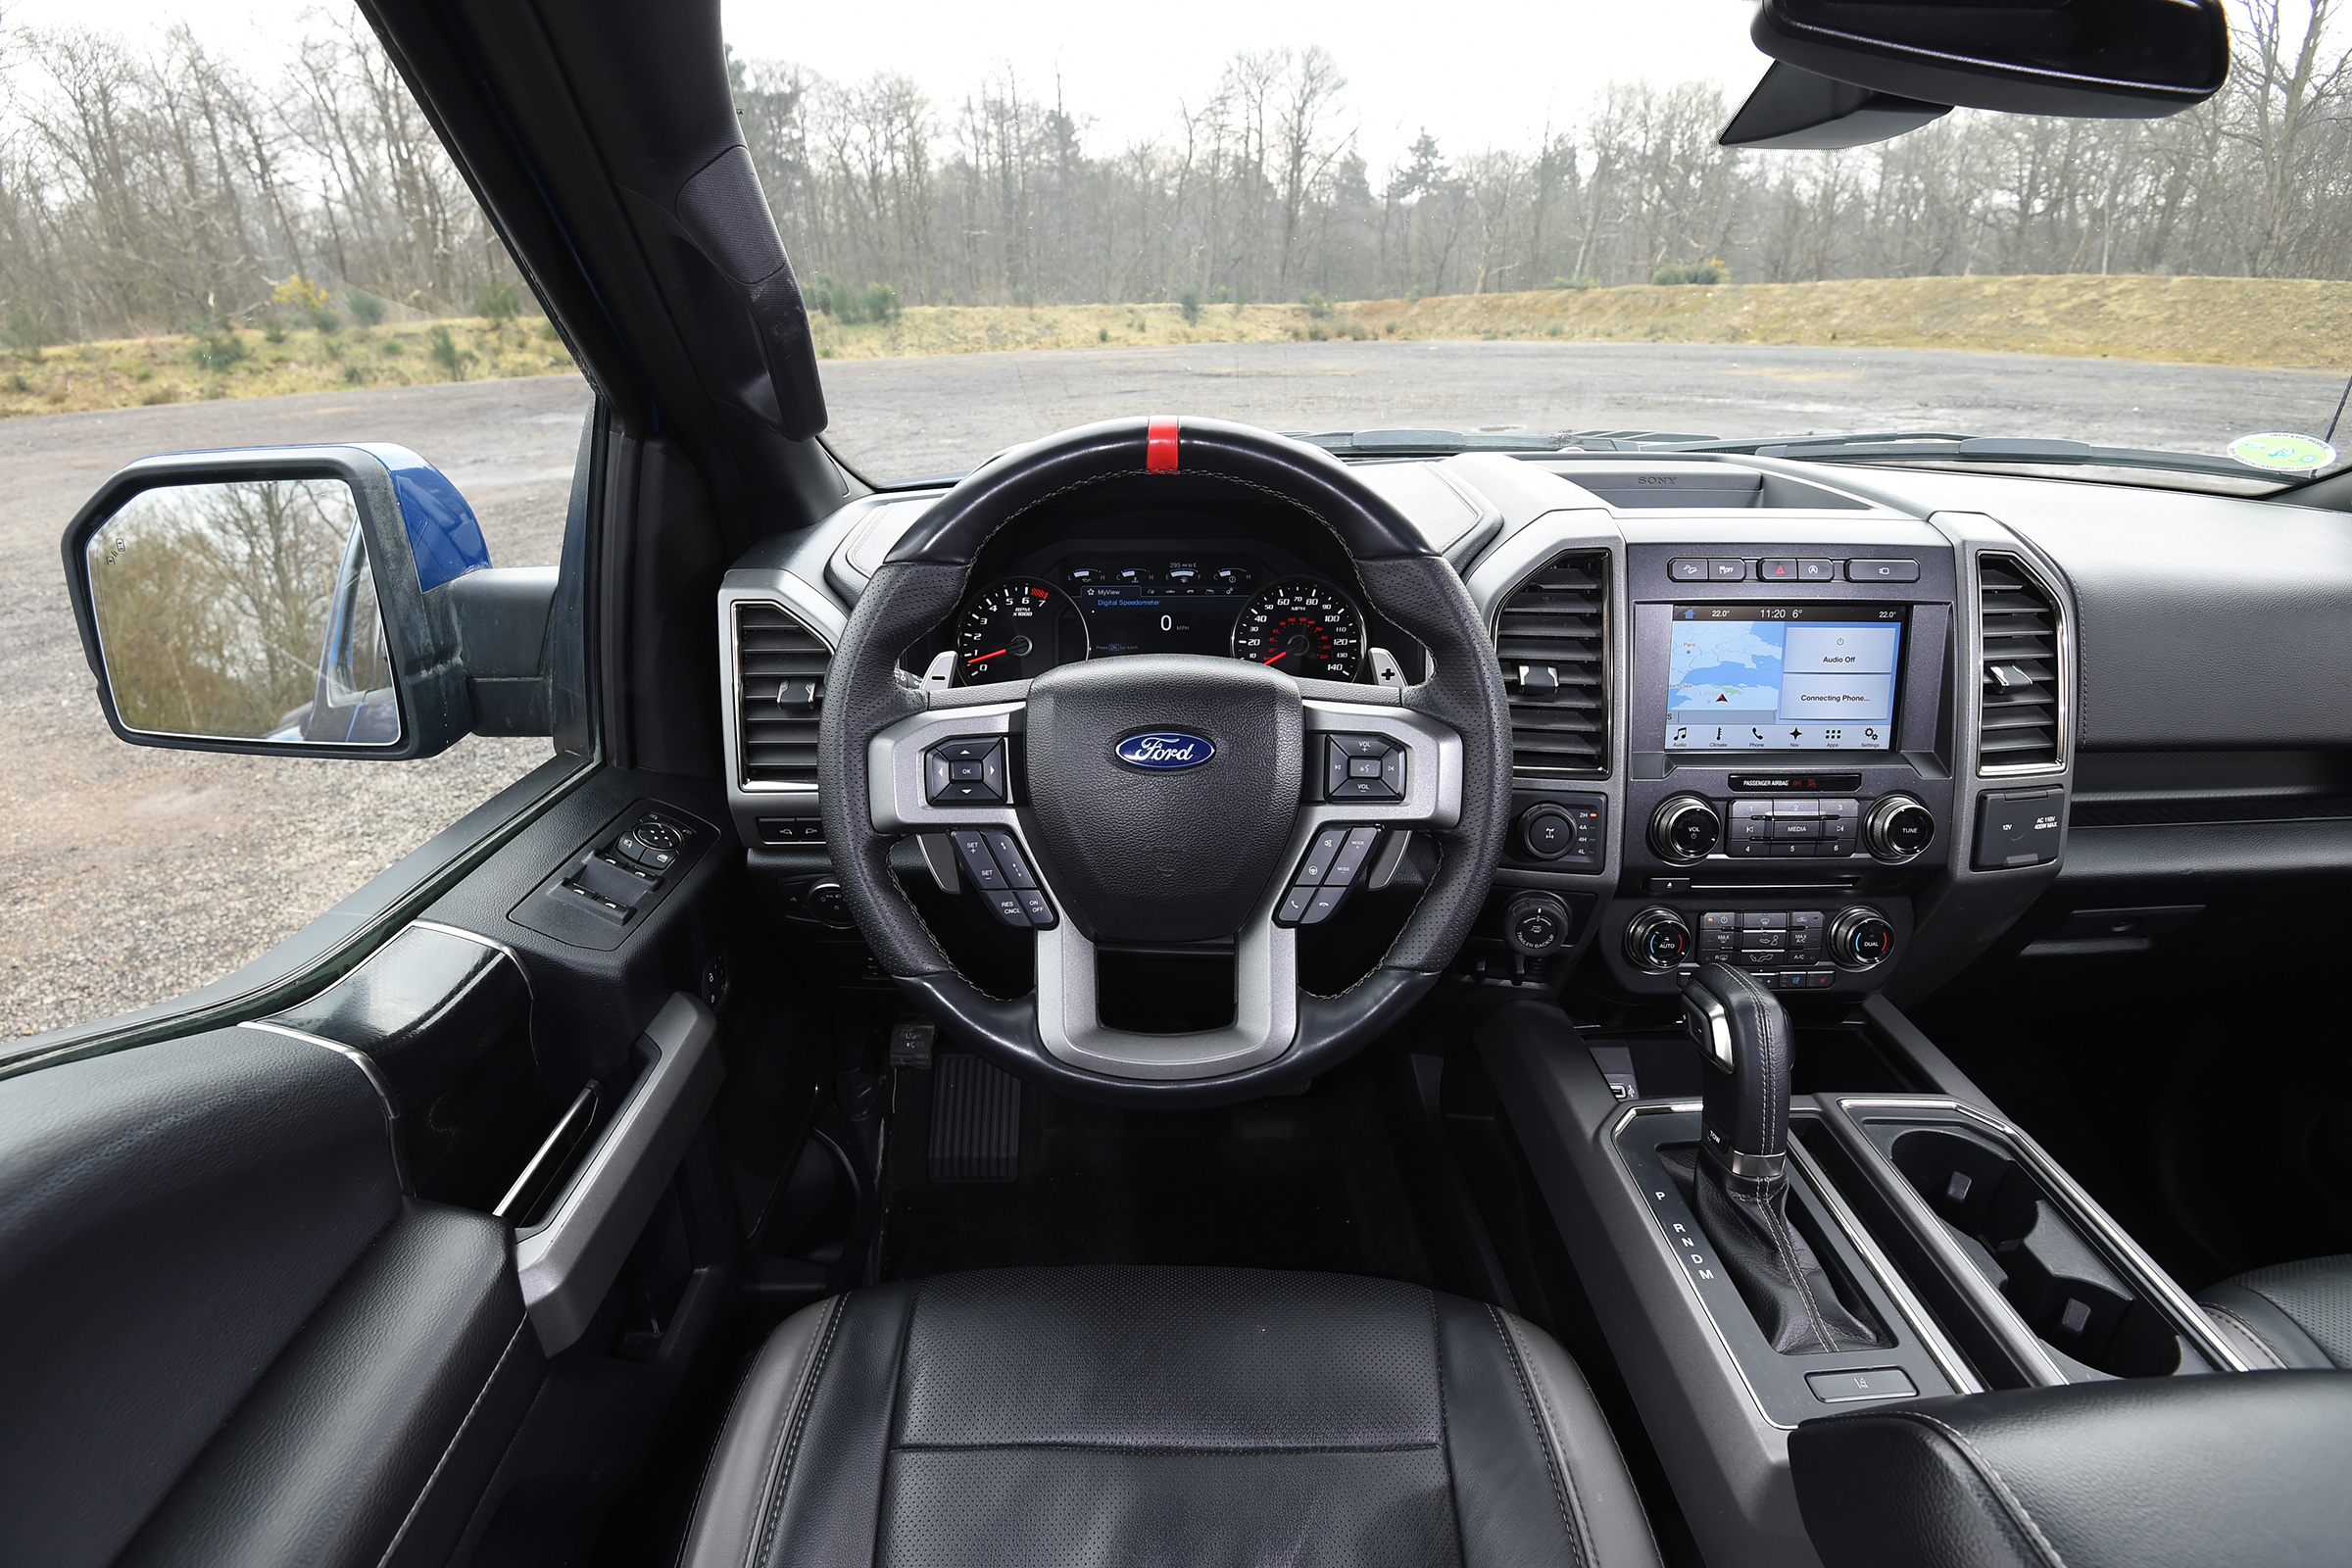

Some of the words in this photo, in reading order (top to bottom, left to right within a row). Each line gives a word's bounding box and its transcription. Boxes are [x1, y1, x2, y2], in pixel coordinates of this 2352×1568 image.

[1638, 476, 1677, 485] SONY
[1760, 609, 1786, 618] 11:20
[1160, 615, 1172, 631] 0
[1124, 737, 1195, 761] Ford
[1517, 932, 1534, 948] TRAILER
[1534, 934, 1555, 948] BACKUP
[1655, 1191, 1665, 1200] P
[1673, 1223, 1686, 1232] R
[1681, 1237, 1694, 1248] N
[1690, 1254, 1703, 1264] D
[1699, 1269, 1714, 1280] M
